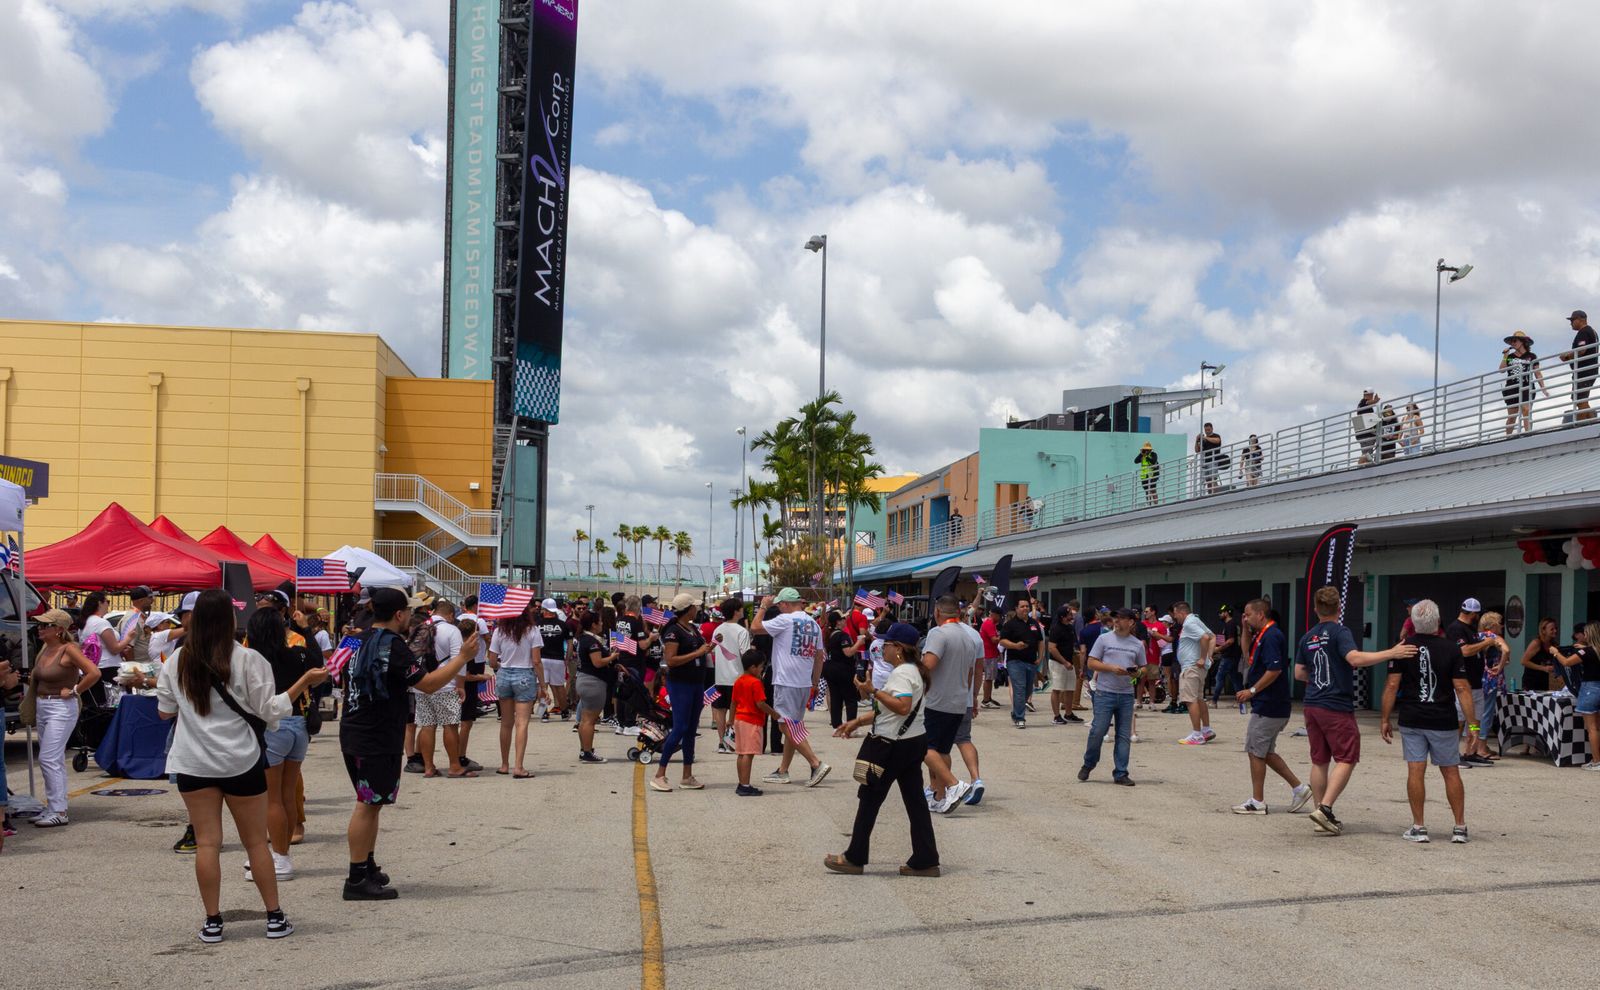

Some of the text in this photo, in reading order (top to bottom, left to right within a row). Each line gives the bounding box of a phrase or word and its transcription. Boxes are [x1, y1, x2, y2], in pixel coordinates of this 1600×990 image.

[547, 72, 565, 137] Corp
[556, 226, 564, 280] AIRCRAFT
[562, 77, 571, 139] HOLDINGS
